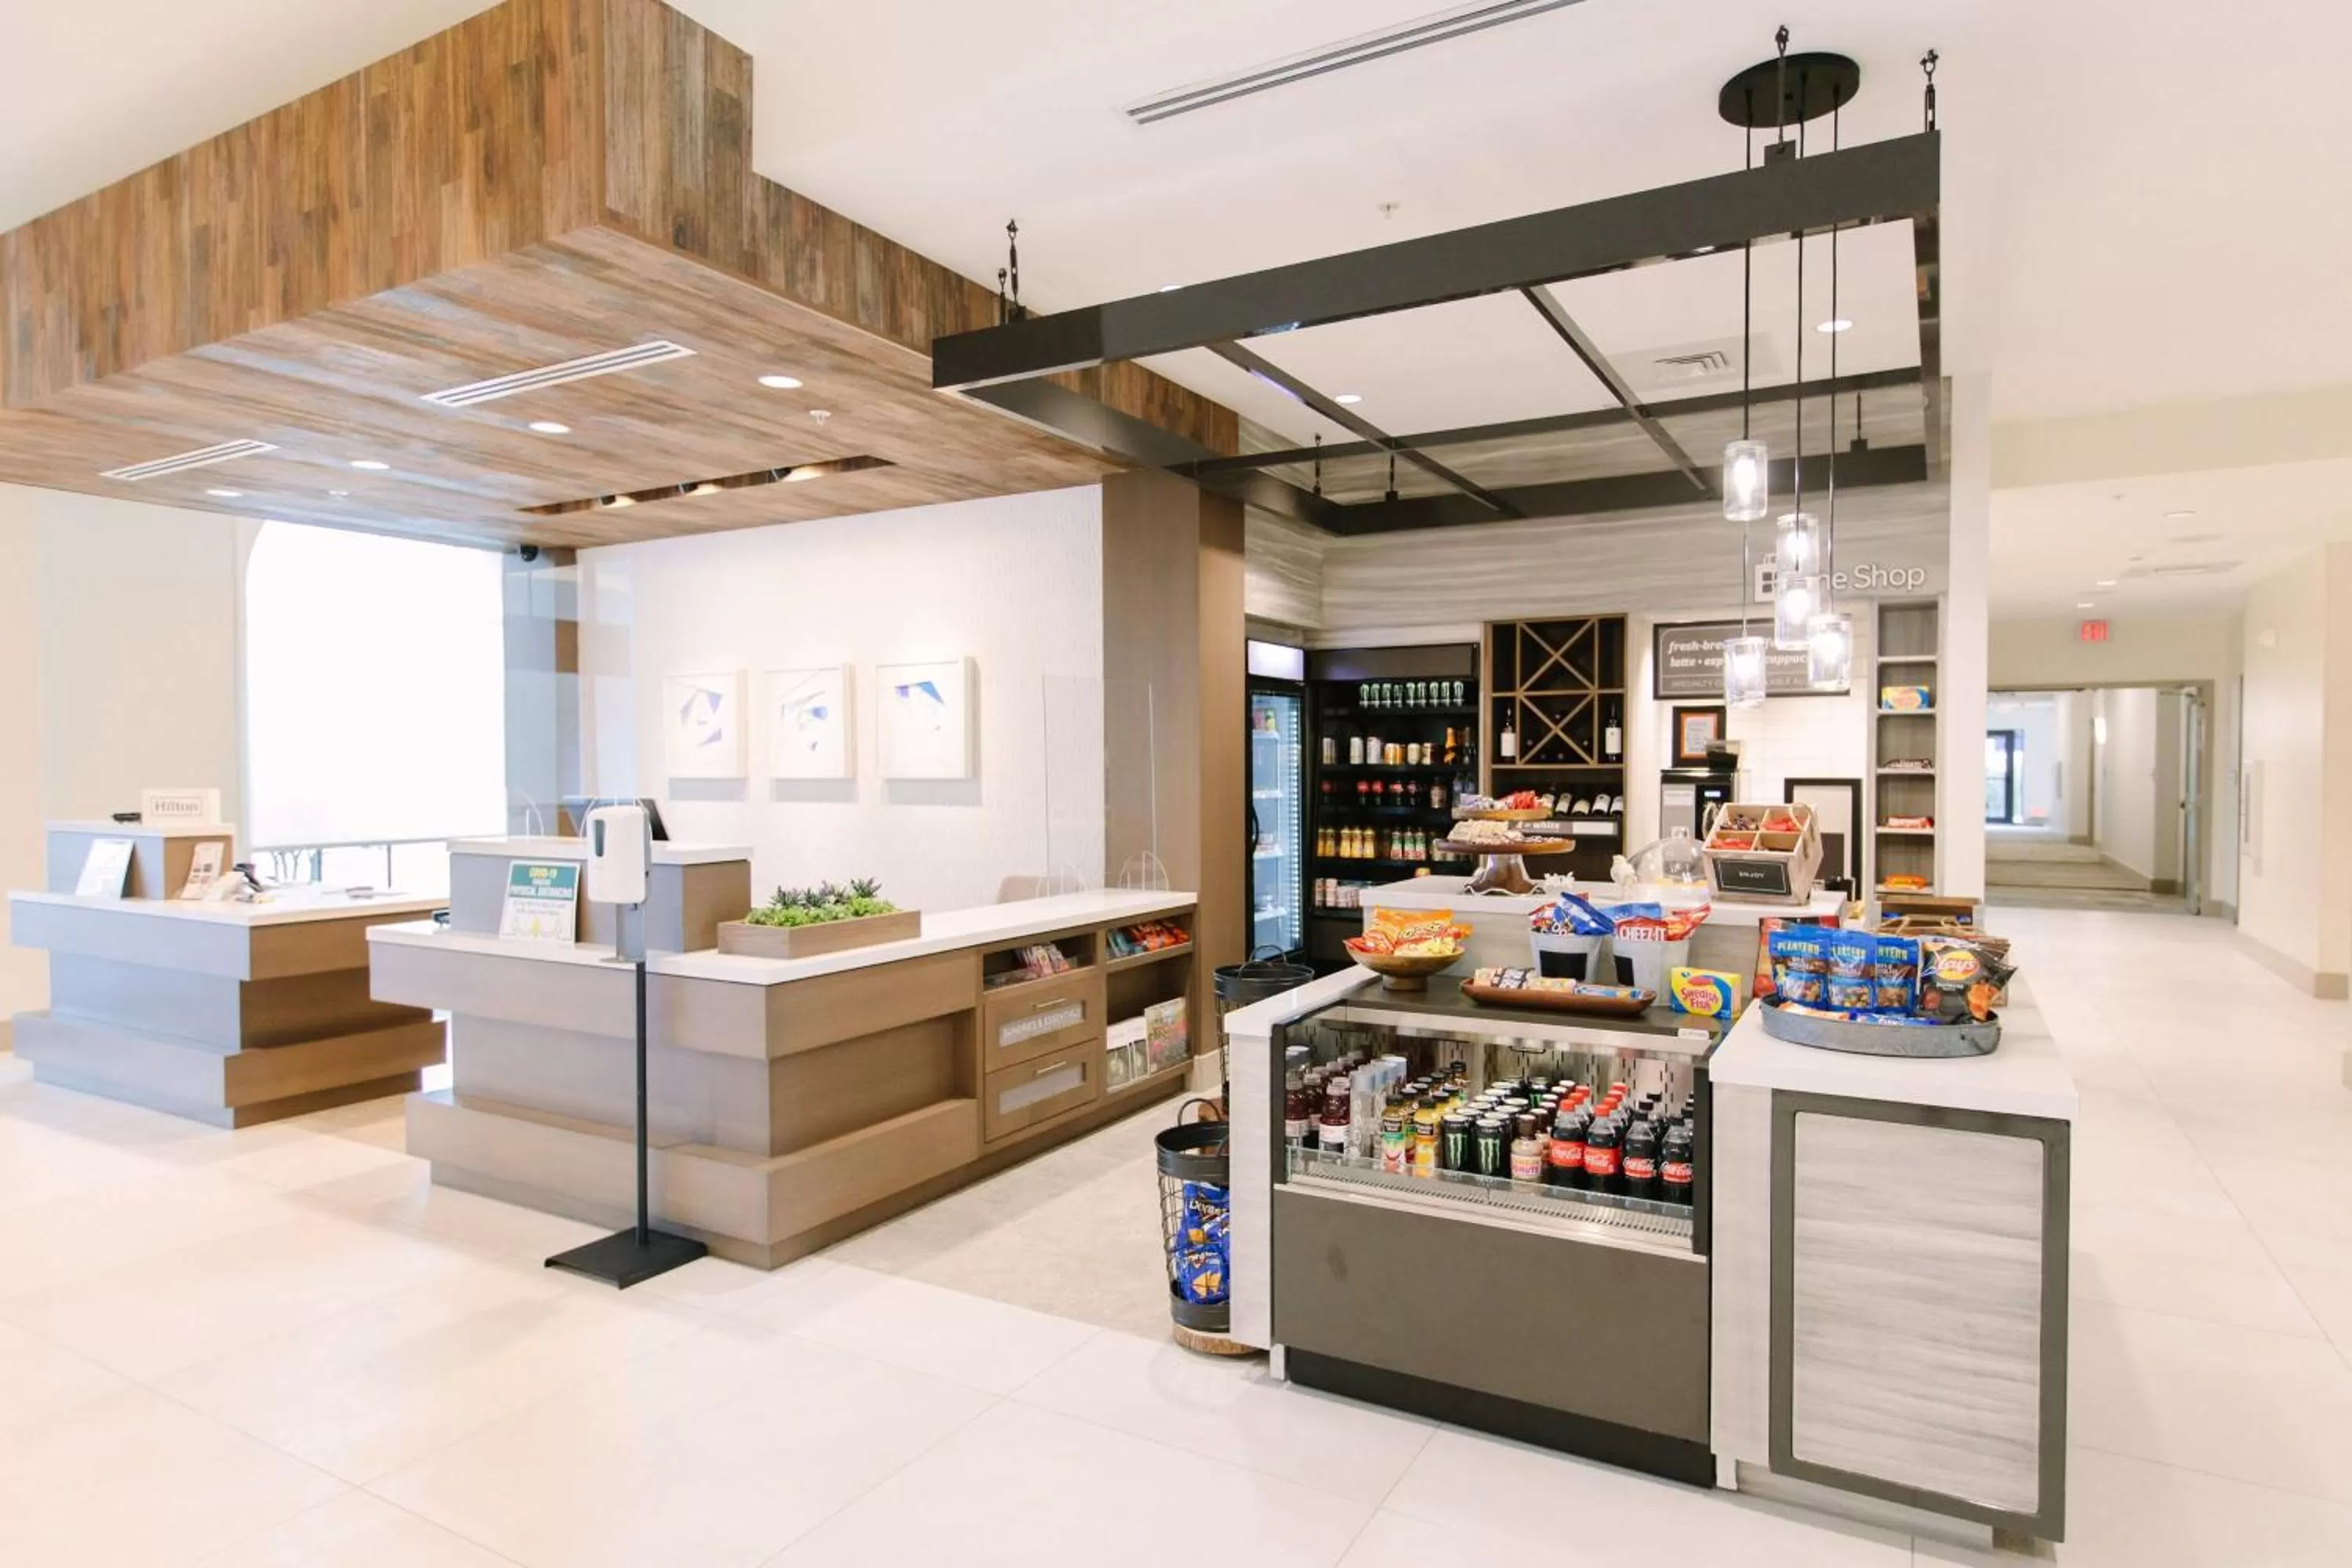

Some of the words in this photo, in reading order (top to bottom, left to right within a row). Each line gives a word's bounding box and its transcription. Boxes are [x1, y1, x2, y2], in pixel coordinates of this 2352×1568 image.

[1853, 564, 1926, 590] Shop
[154, 799, 200, 815] Hilton
[1680, 987, 1719, 1004] Swedish
[1690, 999, 1712, 1011] Fish
